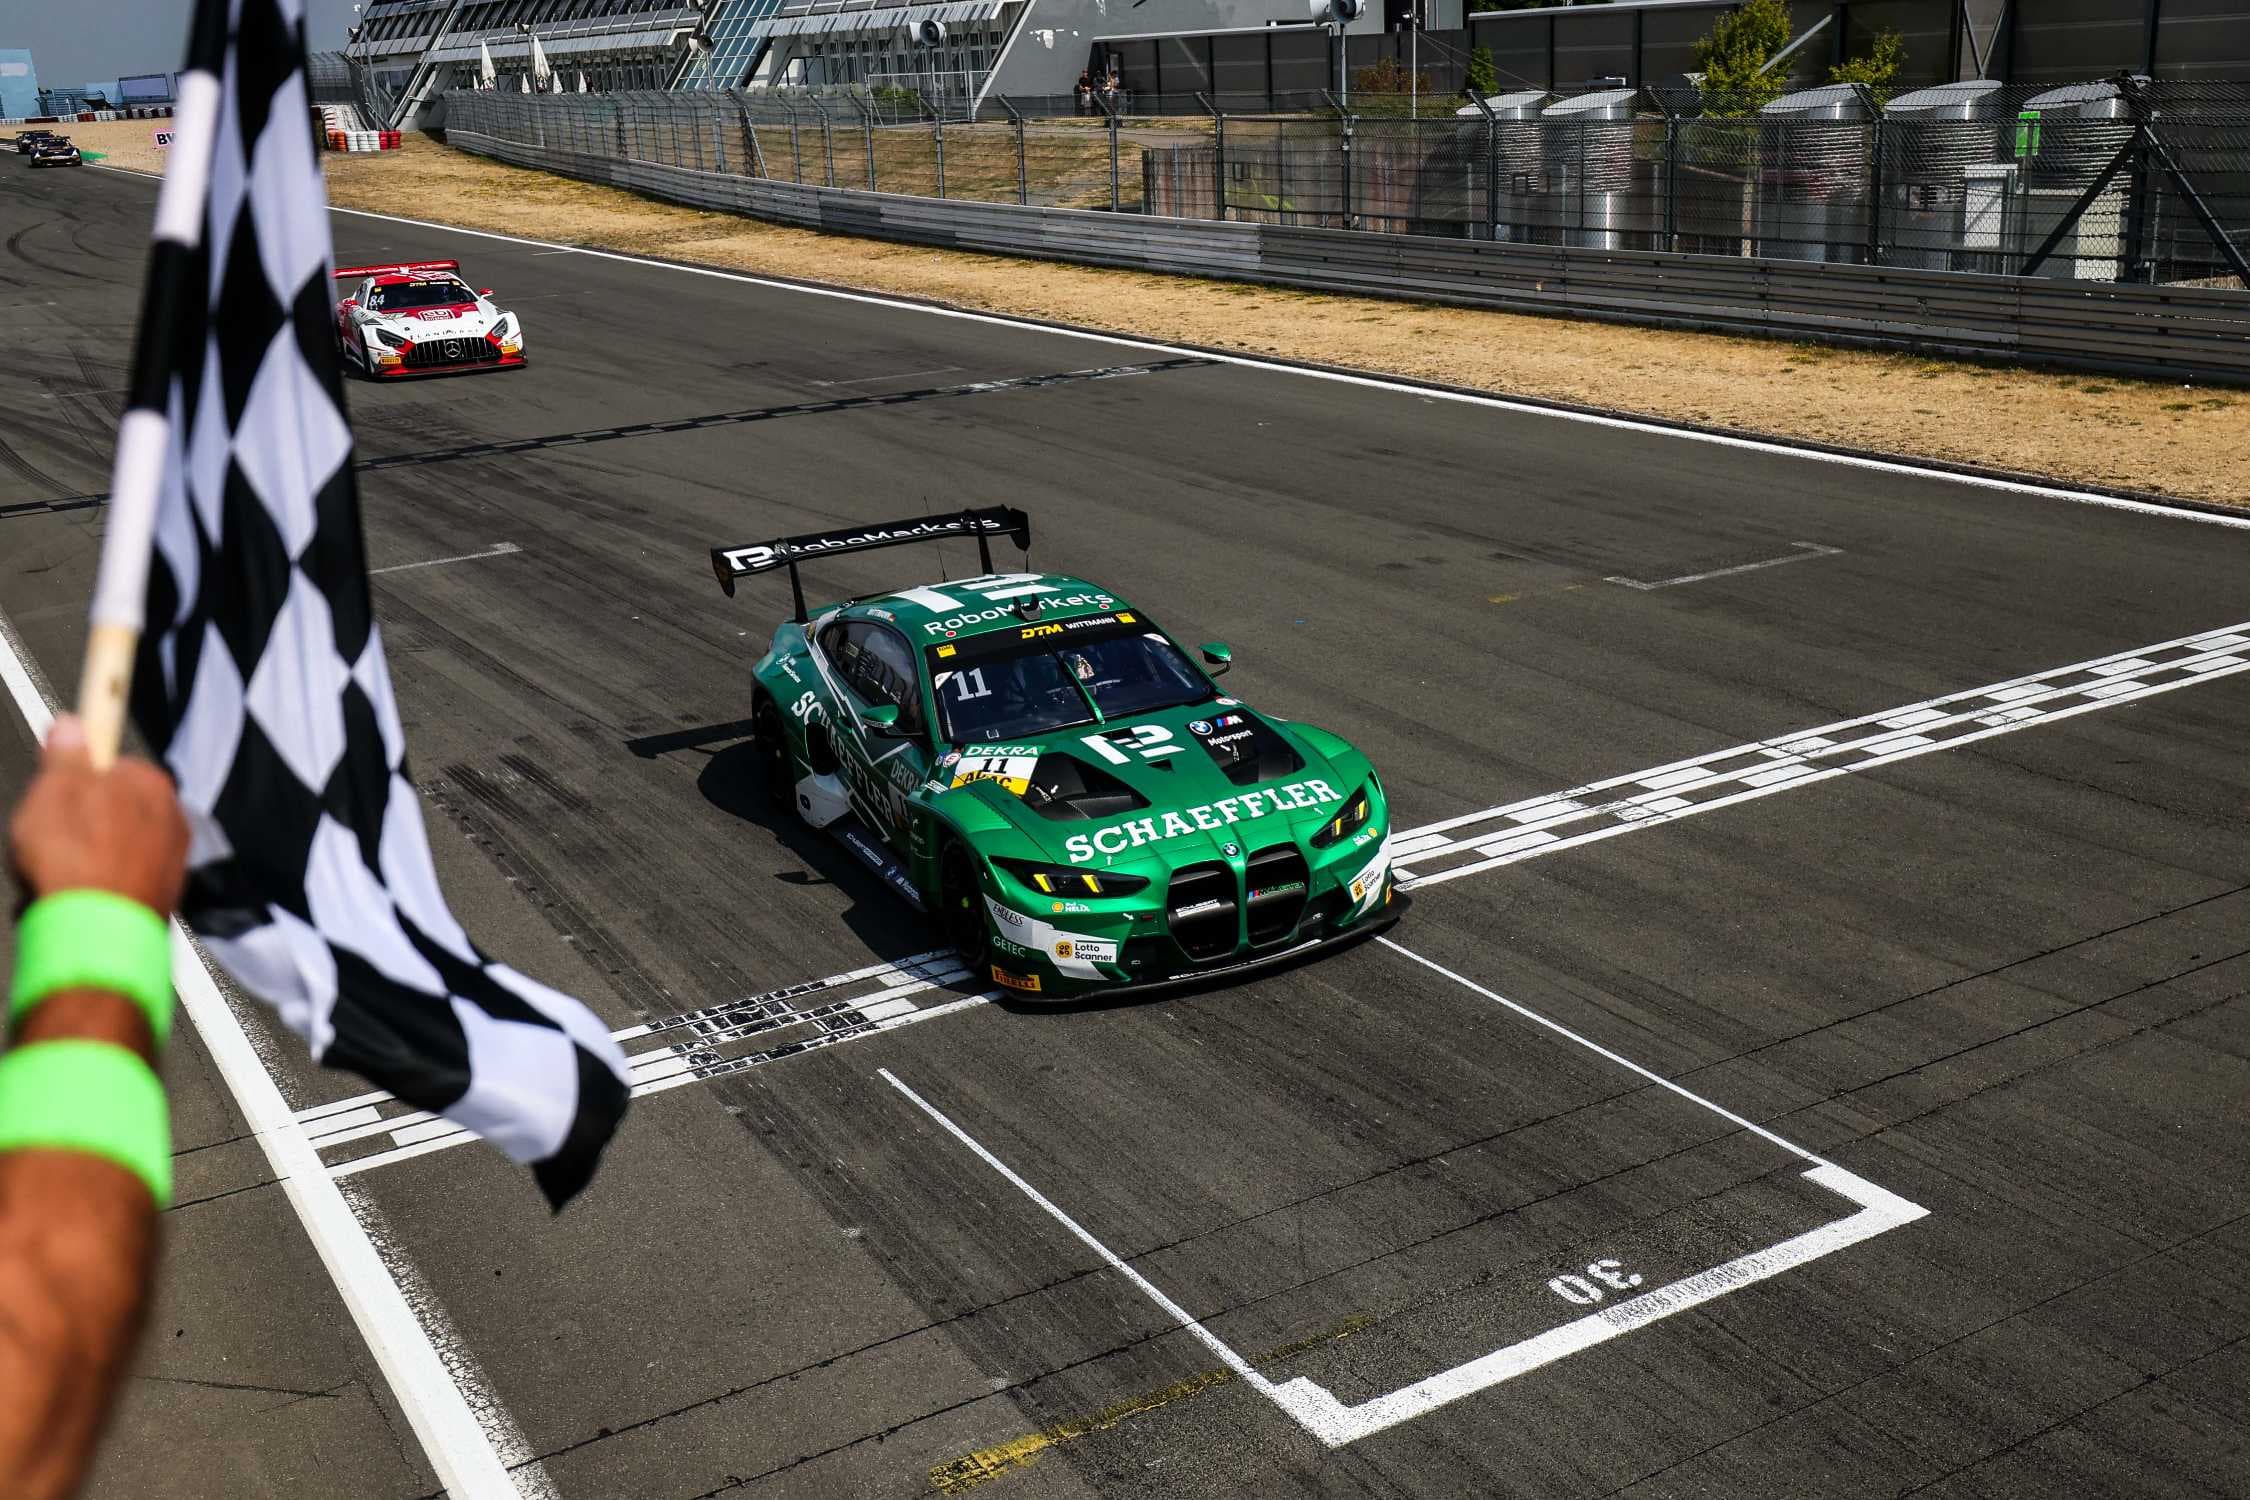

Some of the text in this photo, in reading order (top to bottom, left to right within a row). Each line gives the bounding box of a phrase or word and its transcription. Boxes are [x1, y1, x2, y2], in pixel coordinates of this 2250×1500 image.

[369, 294, 385, 306] 84
[778, 518, 1001, 554] RoboMarkes
[924, 593, 1114, 636] RoboMrkets
[1021, 616, 1116, 639] DTM WITTMANN
[952, 667, 993, 702] 11
[1207, 729, 1254, 747] Motorsport
[965, 746, 1040, 757] DEKRA
[981, 757, 1010, 775] 11
[1065, 779, 1342, 864] SCHAEFFLER
[993, 903, 1025, 925] ENDLESS
[993, 935, 1026, 958] GETEC
[1074, 943, 1100, 952] Lotto
[1074, 951, 1113, 962] Scanner
[1548, 1259, 1643, 1304] 30
